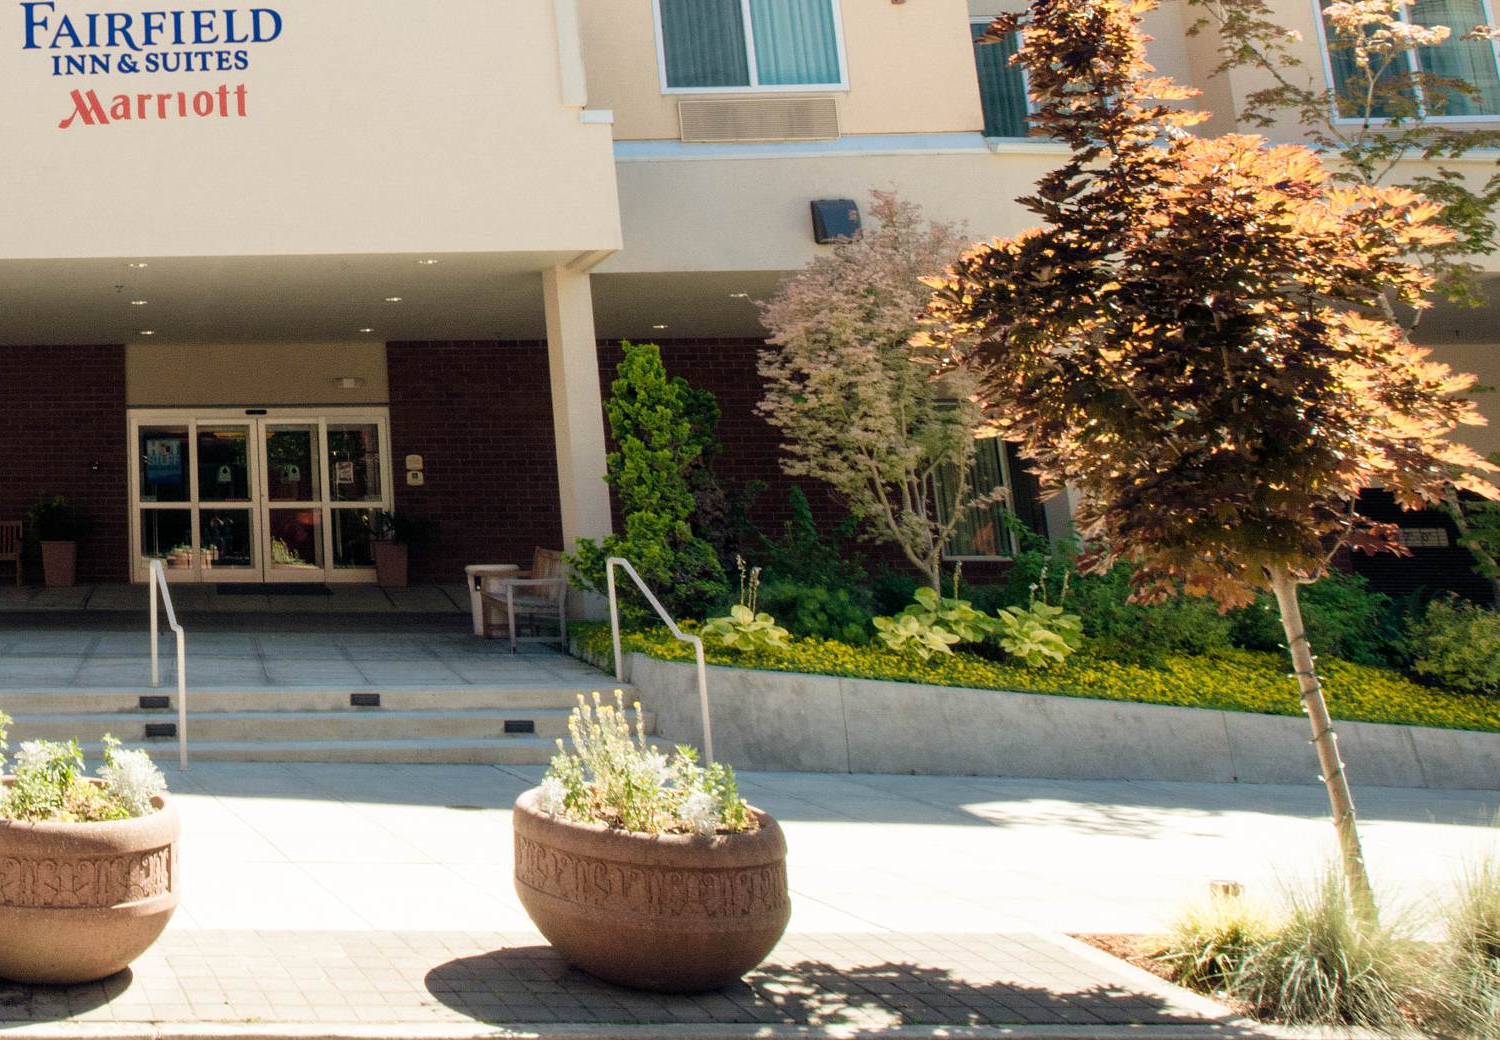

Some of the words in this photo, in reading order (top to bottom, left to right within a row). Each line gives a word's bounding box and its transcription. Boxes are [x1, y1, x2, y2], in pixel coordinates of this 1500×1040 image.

[20, 1, 282, 51] FAIRFIELD
[52, 54, 110, 76] INN
[145, 50, 249, 72] SUITES
[58, 83, 248, 129] Marriott
